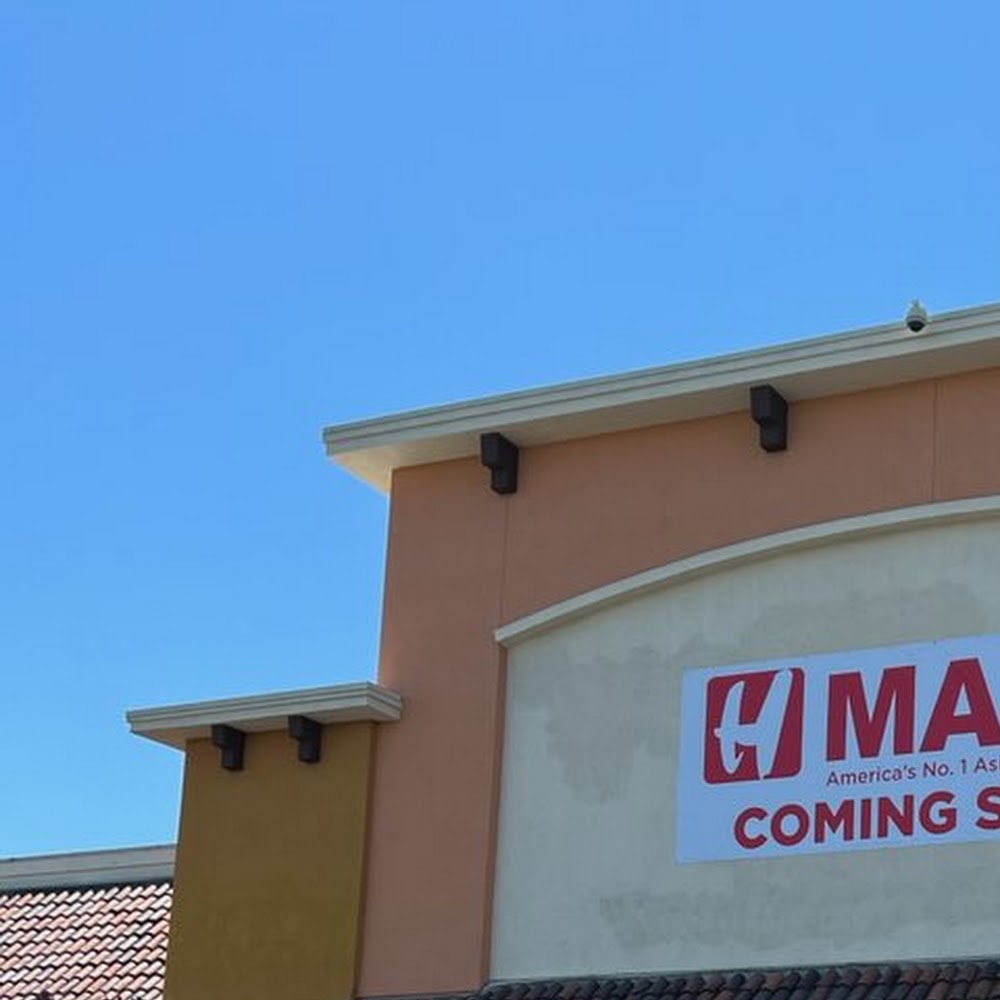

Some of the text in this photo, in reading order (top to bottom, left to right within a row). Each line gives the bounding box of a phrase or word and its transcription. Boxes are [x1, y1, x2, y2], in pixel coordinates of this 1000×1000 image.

[825, 764, 917, 787] America's
[922, 761, 954, 779] No.
[960, 758, 968, 775] 1
[734, 790, 957, 849] COMING
